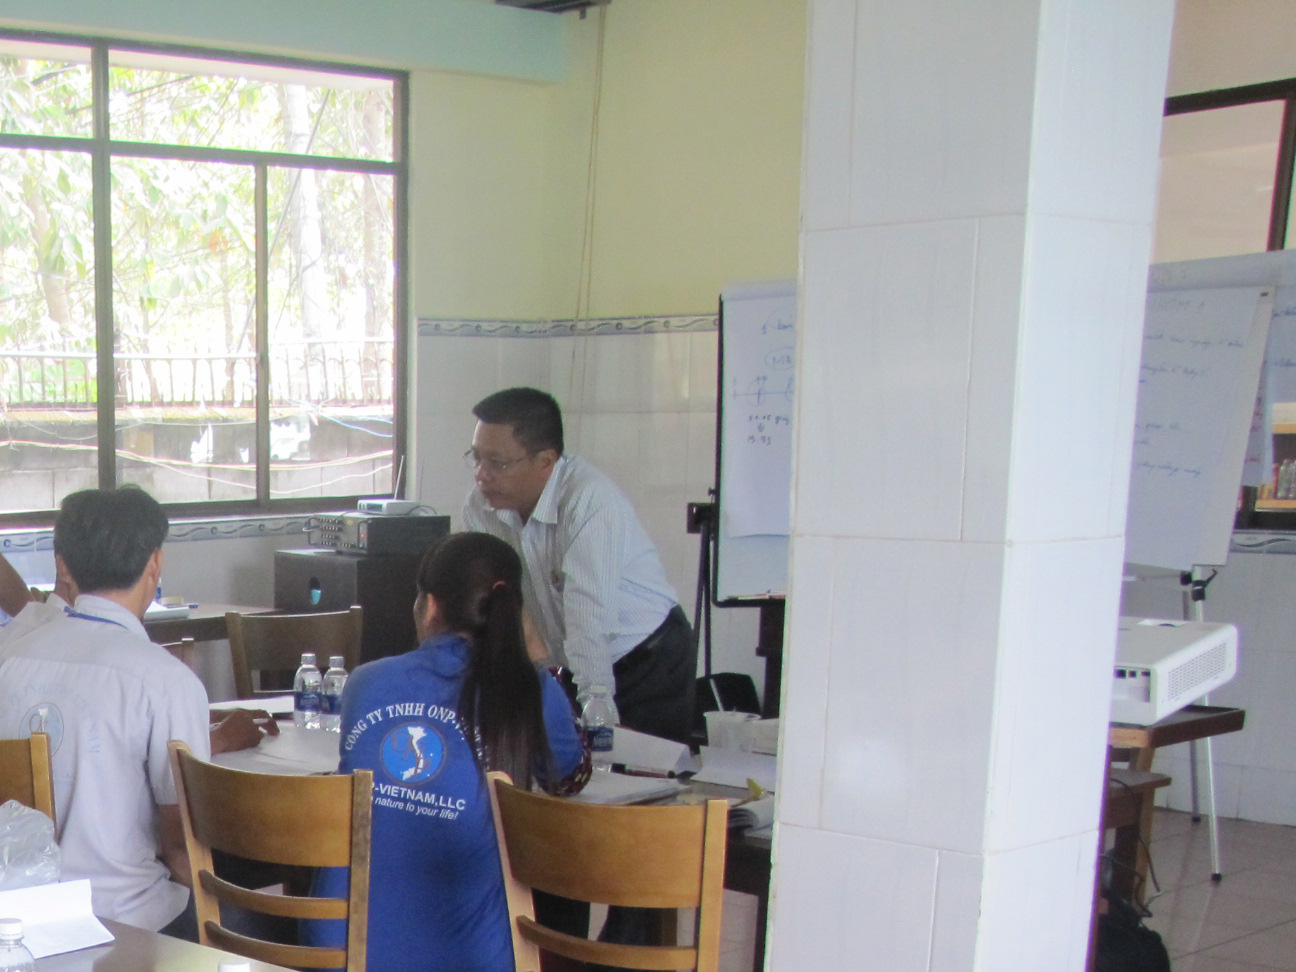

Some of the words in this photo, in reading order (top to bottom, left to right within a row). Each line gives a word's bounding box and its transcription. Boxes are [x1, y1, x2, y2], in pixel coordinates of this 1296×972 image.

[366, 708, 383, 725] TY
[385, 702, 425, 718] TNHH
[375, 797, 404, 810] nature
[405, 801, 415, 812] to
[415, 804, 438, 816] your
